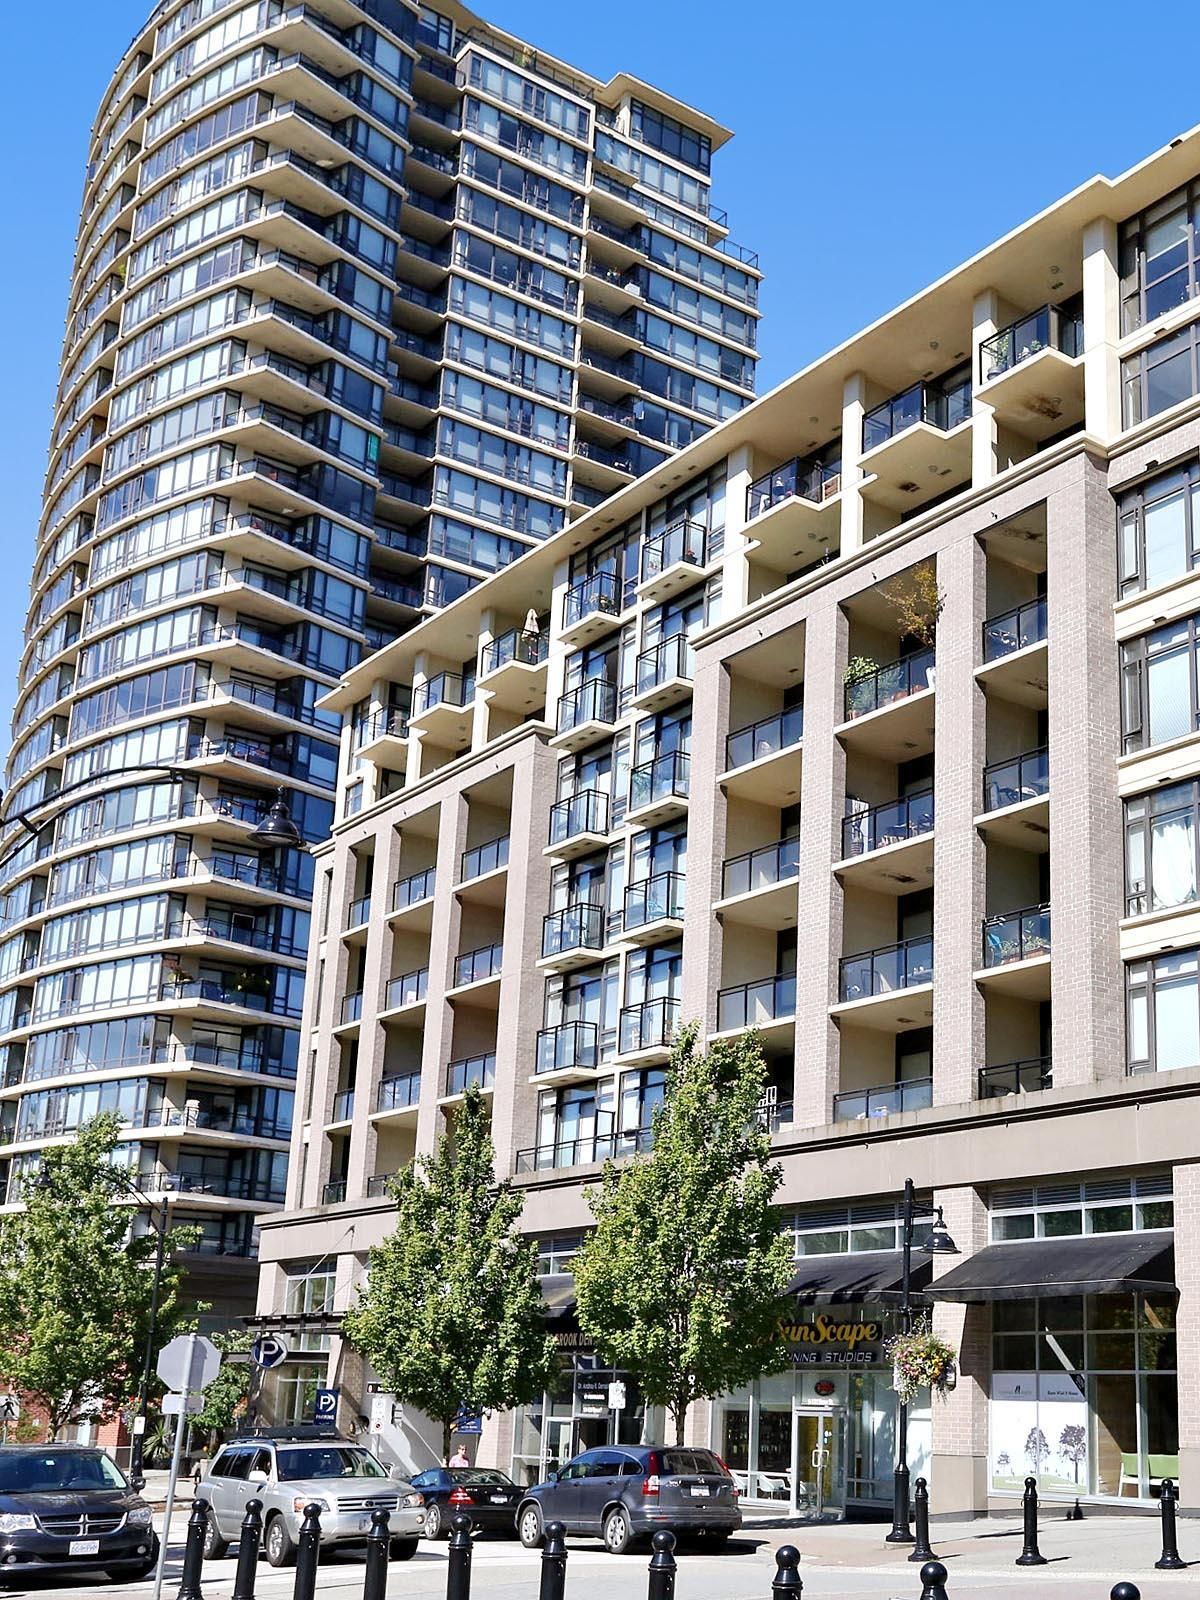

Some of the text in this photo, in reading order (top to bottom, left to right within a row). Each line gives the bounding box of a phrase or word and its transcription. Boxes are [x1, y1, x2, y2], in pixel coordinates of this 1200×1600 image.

[260, 1341, 278, 1363] P
[825, 1352, 872, 1362] STUDIOS
[320, 1396, 331, 1409] P
